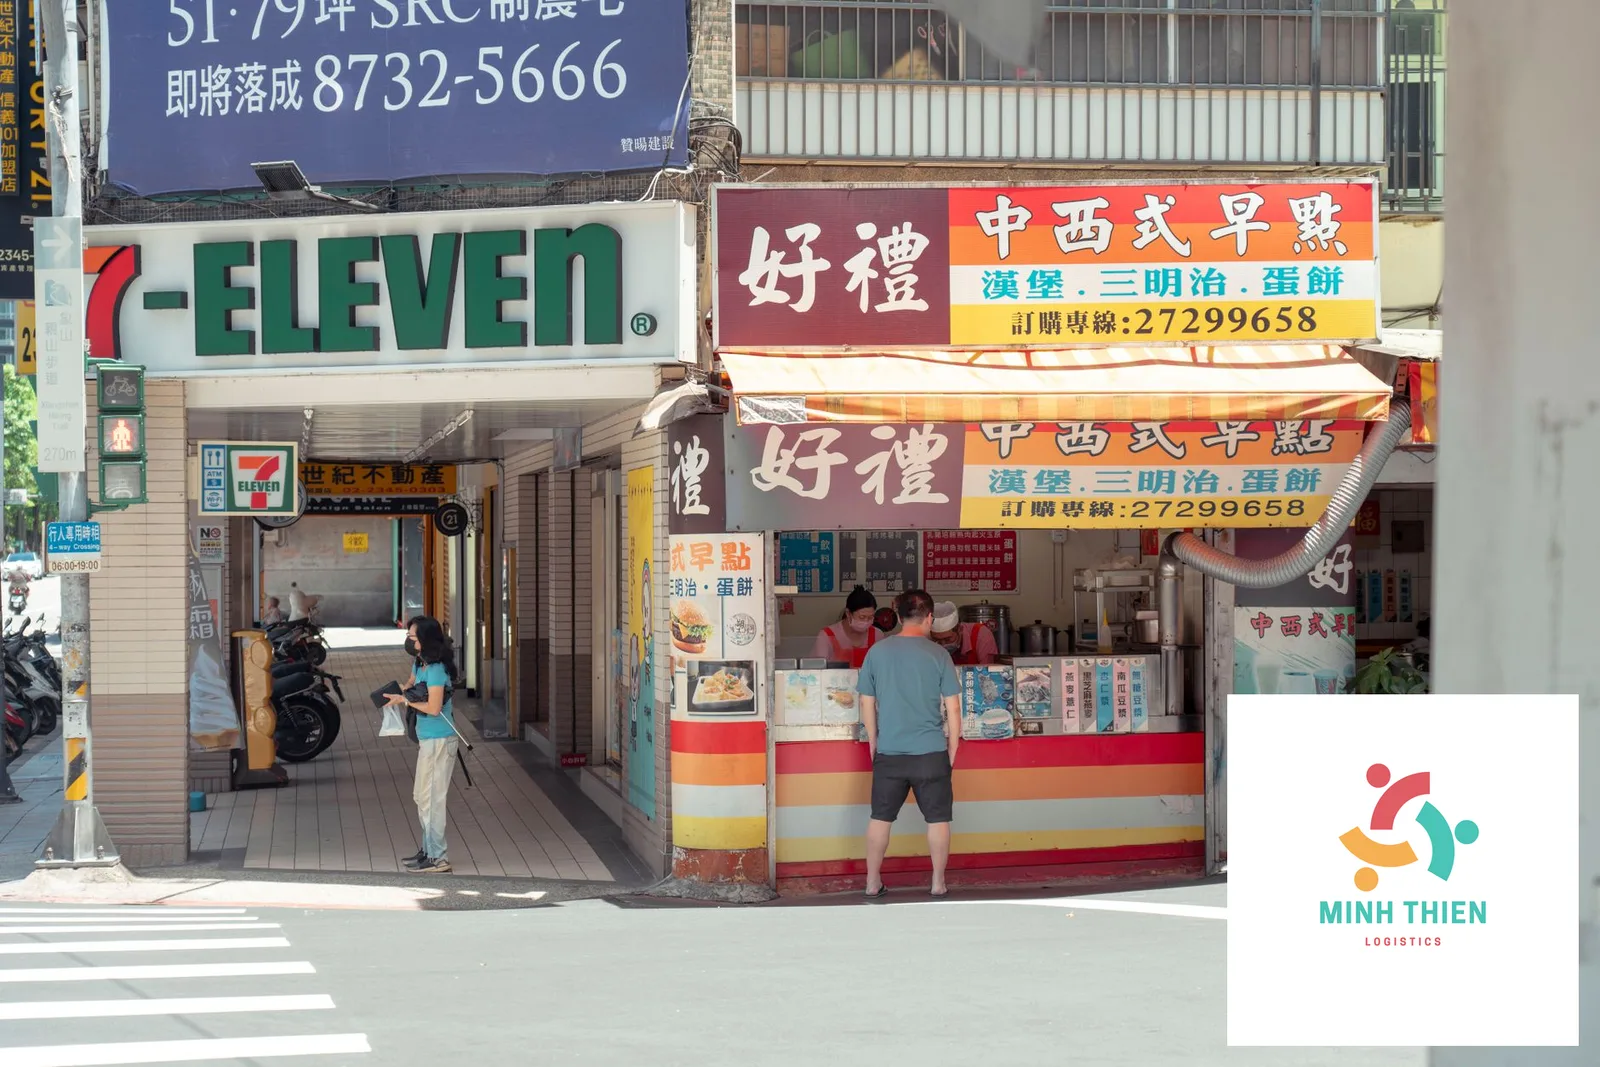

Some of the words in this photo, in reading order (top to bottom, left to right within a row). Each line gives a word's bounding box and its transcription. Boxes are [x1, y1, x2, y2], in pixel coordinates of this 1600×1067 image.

[165, 62, 303, 119] 即將落成
[312, 38, 627, 113] 8732-5666
[974, 190, 1349, 261] 中西式早點
[738, 221, 930, 314] 好禮
[671, 435, 710, 515] 禮
[750, 424, 949, 505] 好禮
[51, 560, 99, 571] 06:00-19:00
[905, 539, 915, 564] 其他
[1307, 544, 1353, 594] 好
